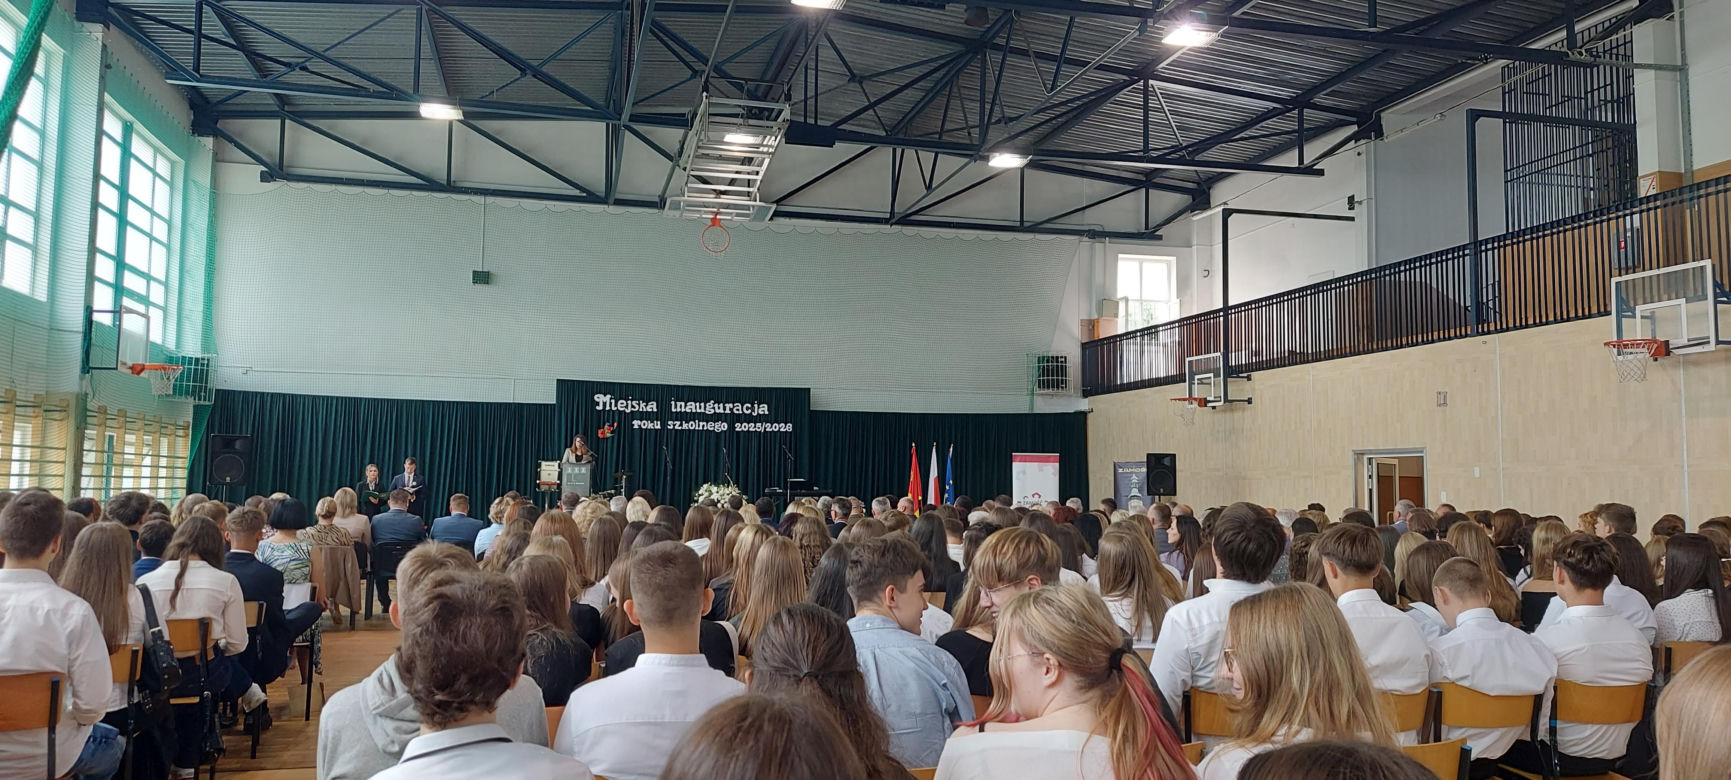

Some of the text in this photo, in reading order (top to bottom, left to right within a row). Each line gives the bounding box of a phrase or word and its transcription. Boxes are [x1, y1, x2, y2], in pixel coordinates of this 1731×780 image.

[594, 394, 769, 415] Miejska inauguracja
[667, 419, 728, 432] szkolnego
